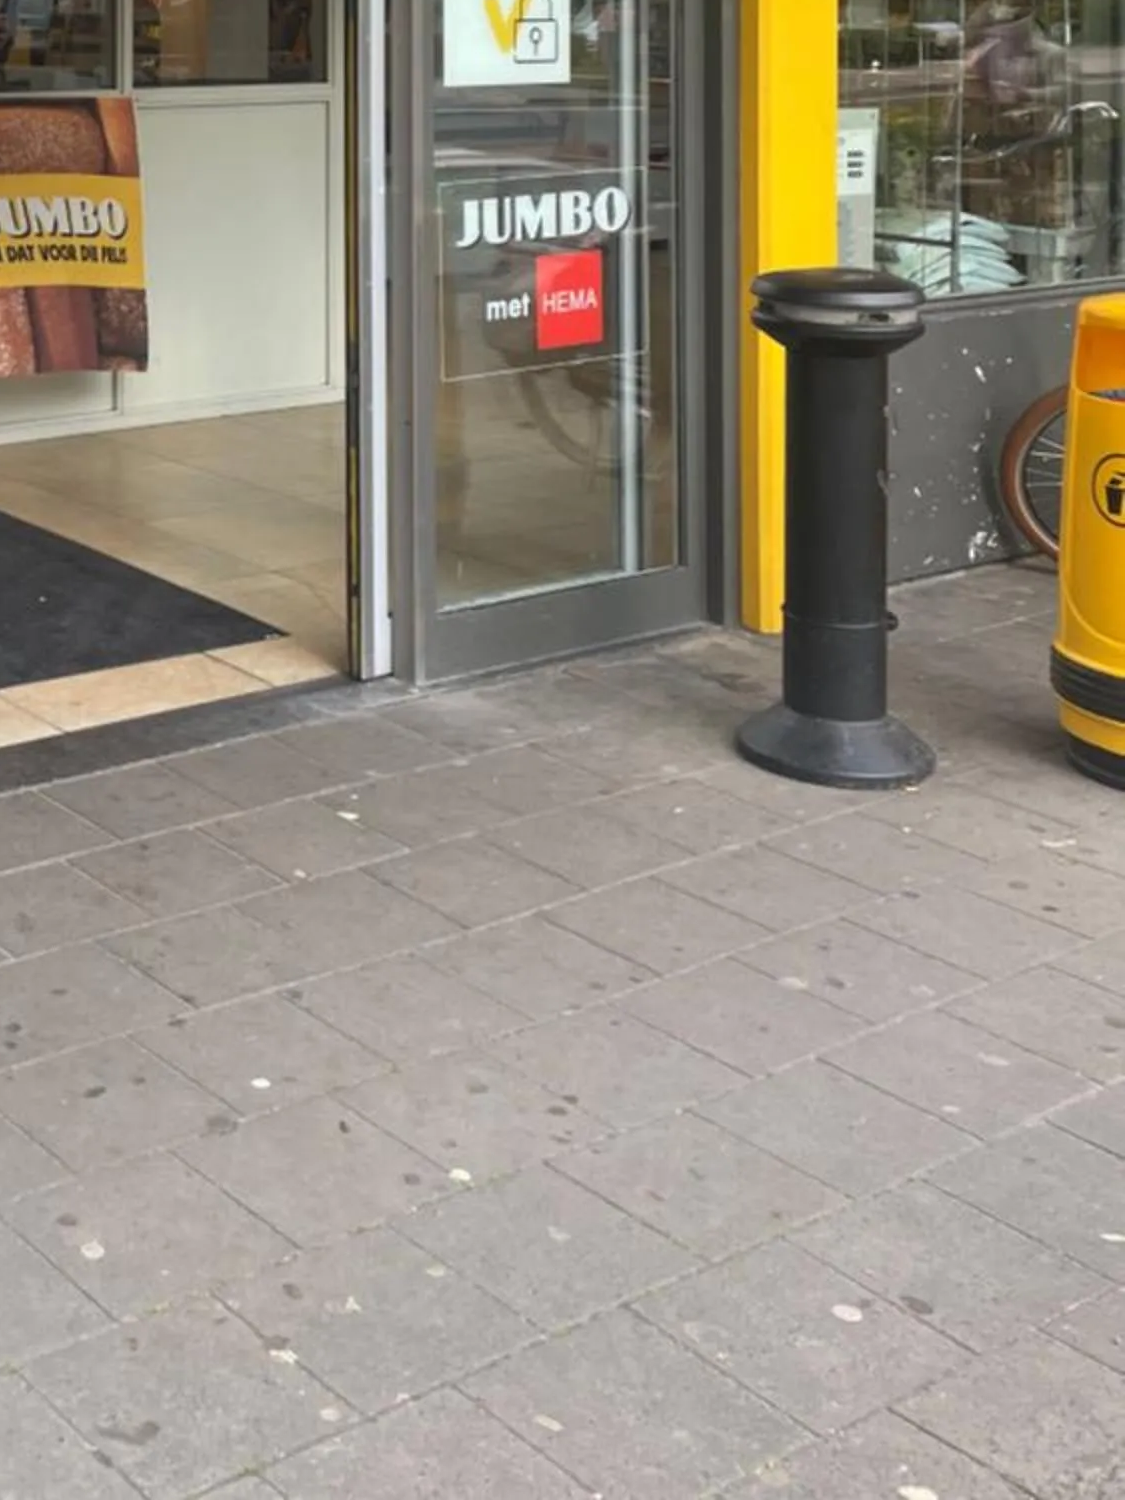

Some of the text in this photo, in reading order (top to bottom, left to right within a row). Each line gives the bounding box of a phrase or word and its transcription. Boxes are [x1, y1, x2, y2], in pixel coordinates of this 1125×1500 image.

[455, 186, 630, 248] JUMBO
[7, 244, 36, 263] DAT
[38, 244, 78, 262] VOOR
[486, 287, 598, 322] met HEMA
